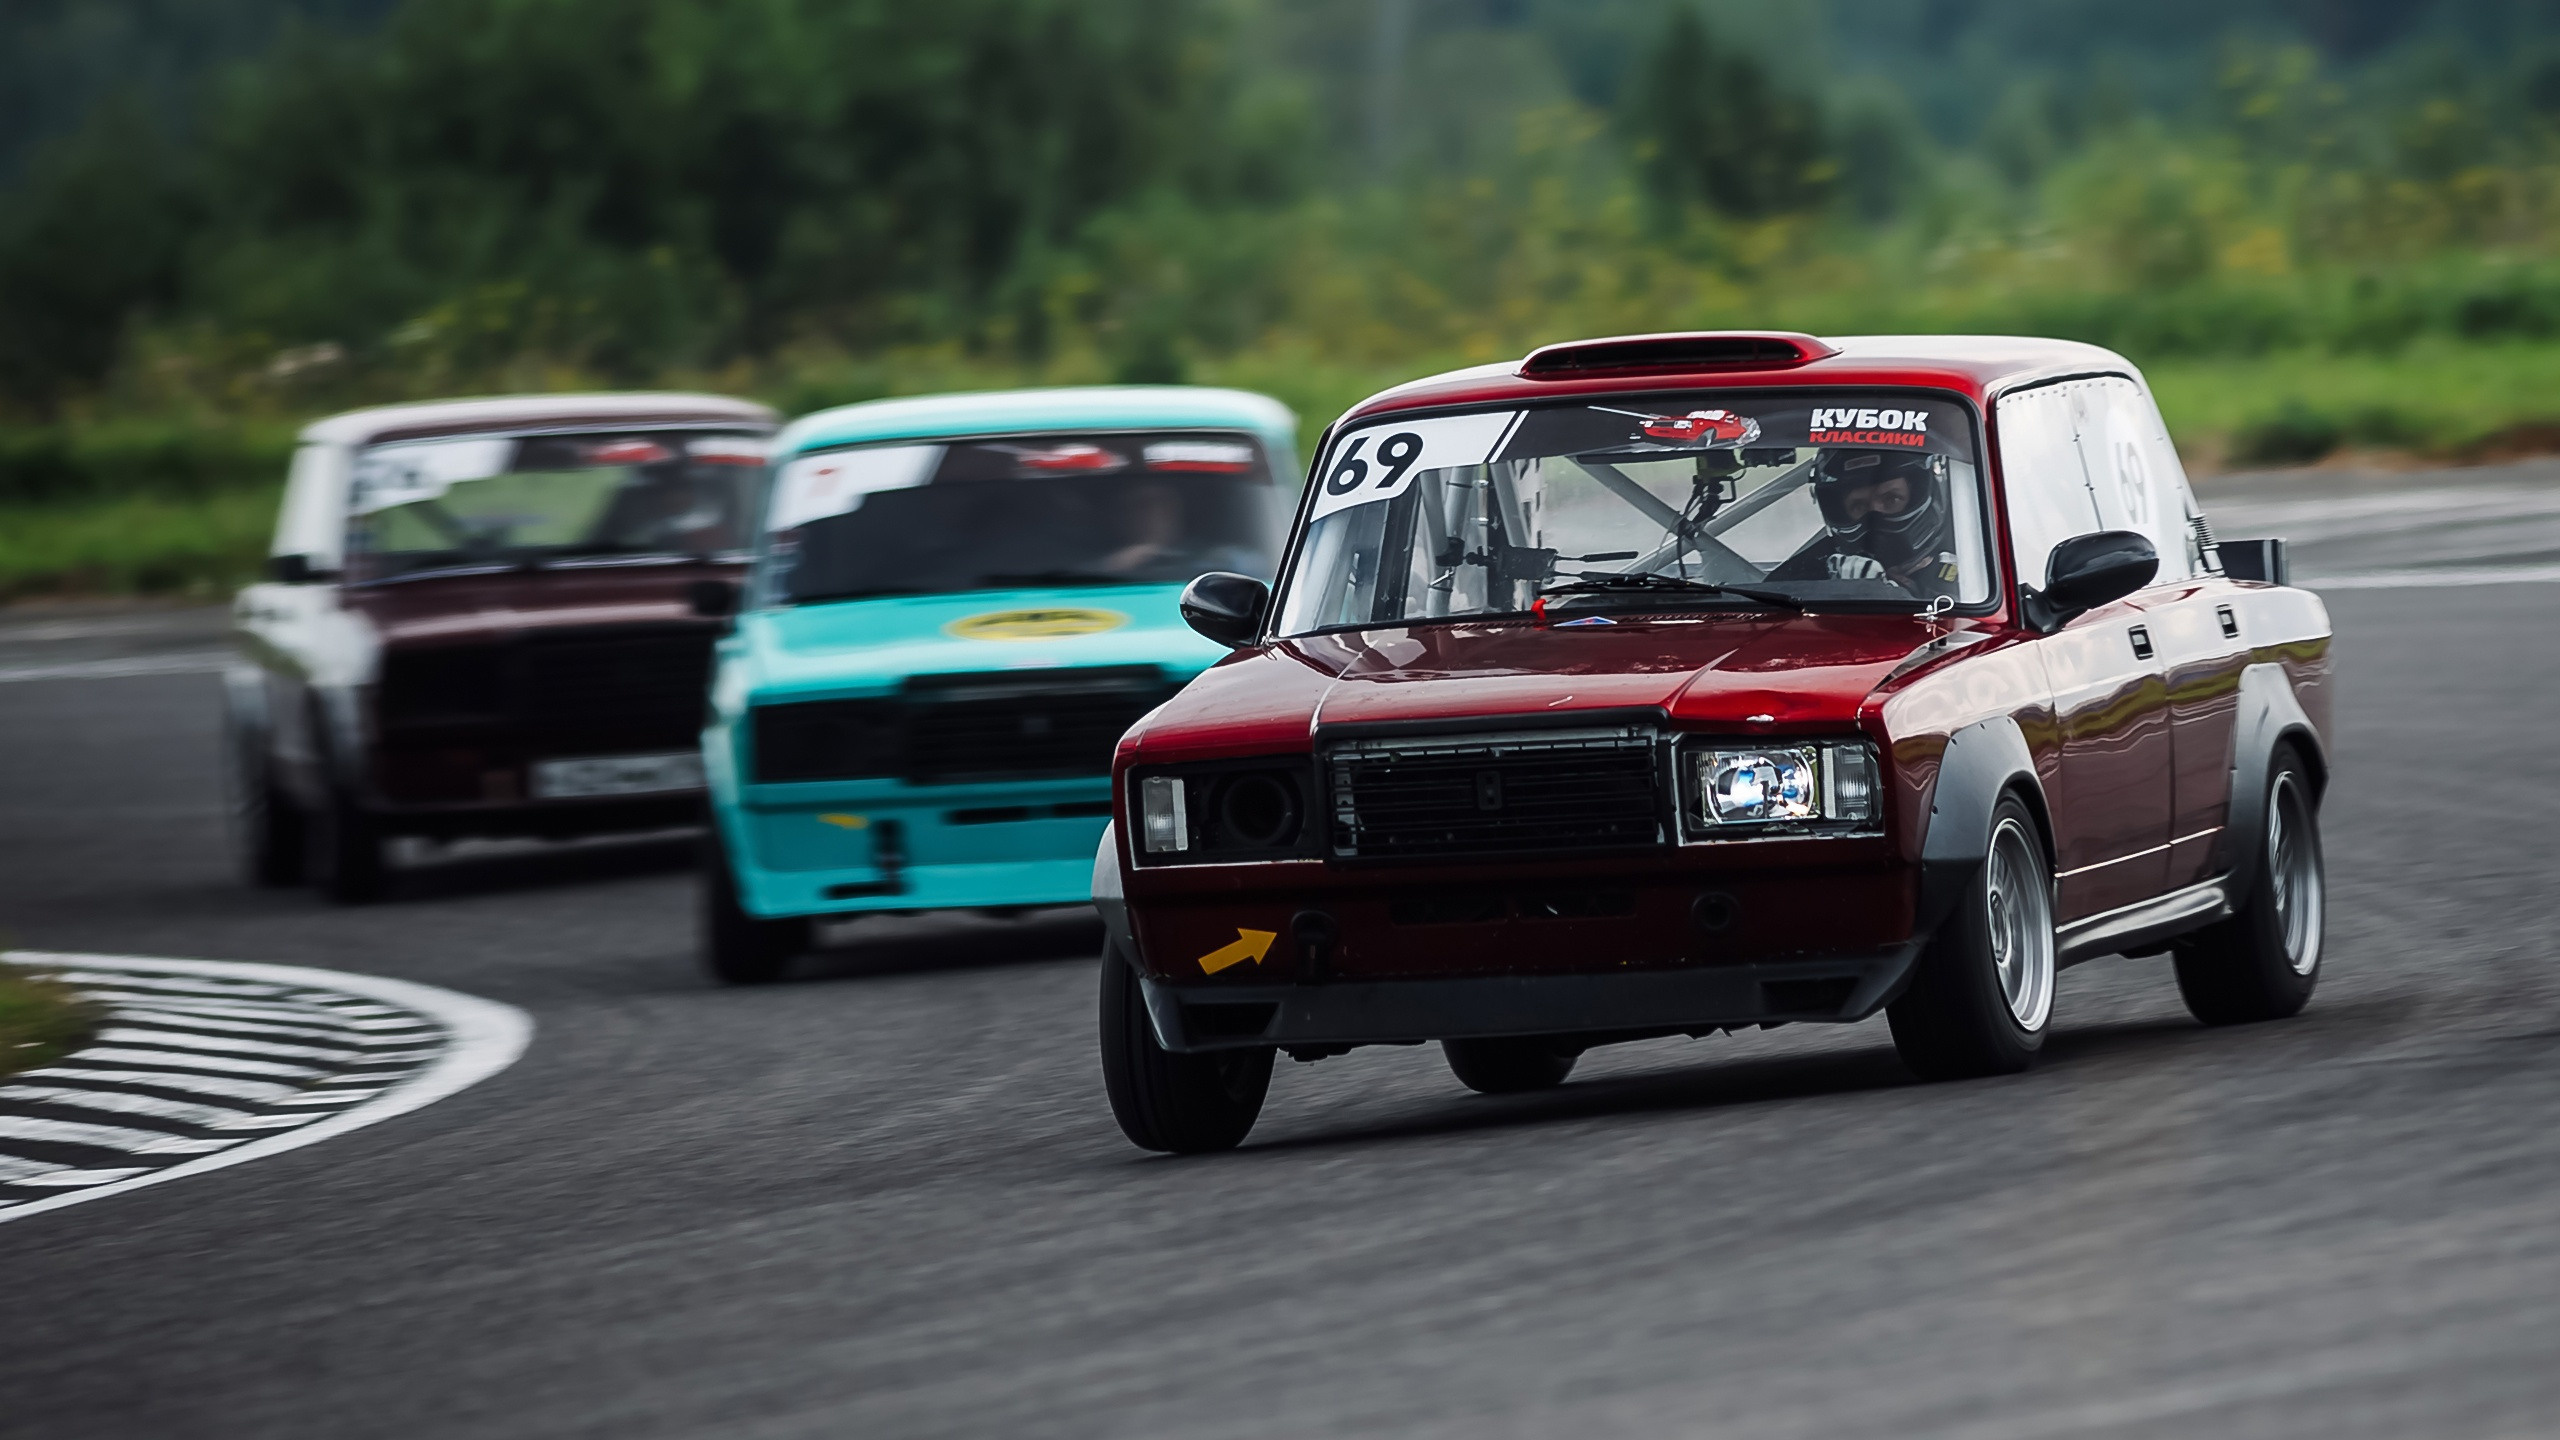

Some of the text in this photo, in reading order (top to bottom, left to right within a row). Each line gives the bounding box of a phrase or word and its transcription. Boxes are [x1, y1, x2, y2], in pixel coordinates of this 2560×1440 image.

[1810, 408, 1929, 431] КУБОК
[1809, 431, 1925, 447] КЛАССИКИ
[1327, 432, 1424, 496] 69
